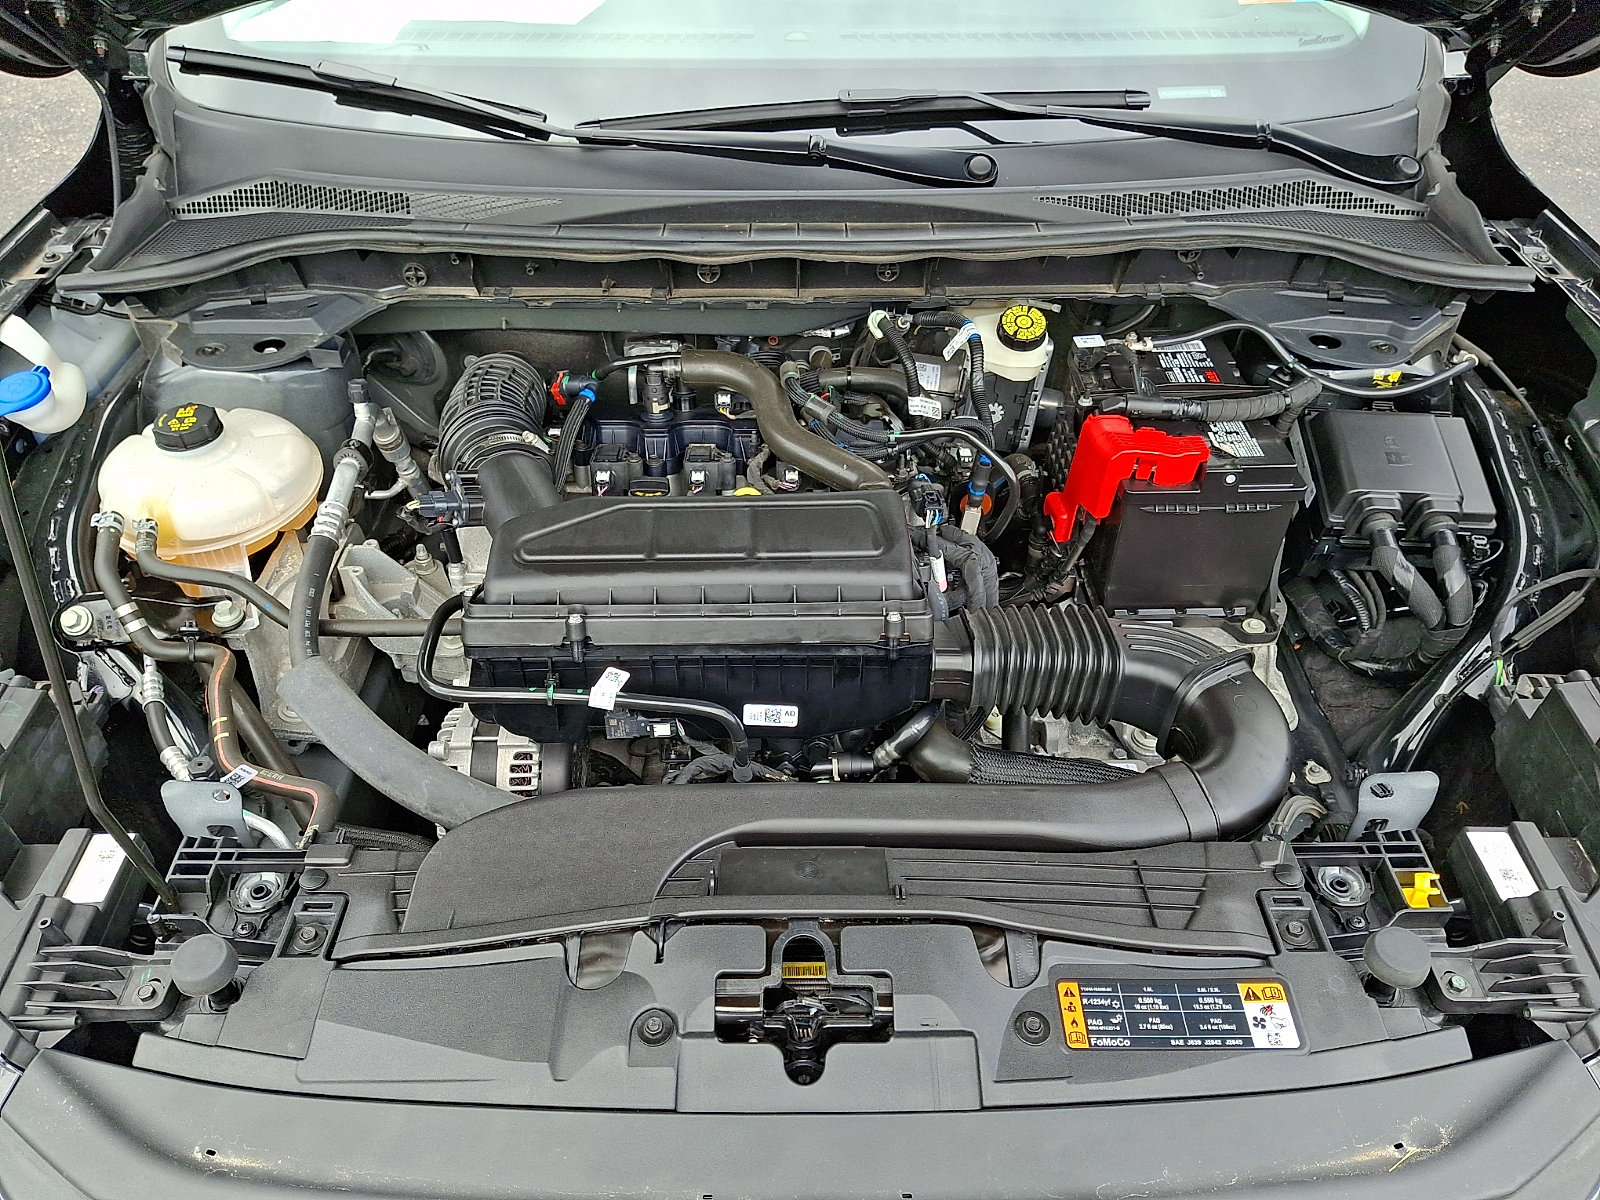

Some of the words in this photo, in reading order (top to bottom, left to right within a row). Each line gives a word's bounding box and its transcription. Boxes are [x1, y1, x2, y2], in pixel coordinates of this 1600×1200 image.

[1082, 997, 1111, 1007] R-1234yf
[1154, 997, 1162, 1005] kg
[1215, 997, 1223, 1005] kg
[1087, 1018, 1104, 1026] PAG
[1090, 1037, 1131, 1047] FoMoCo
